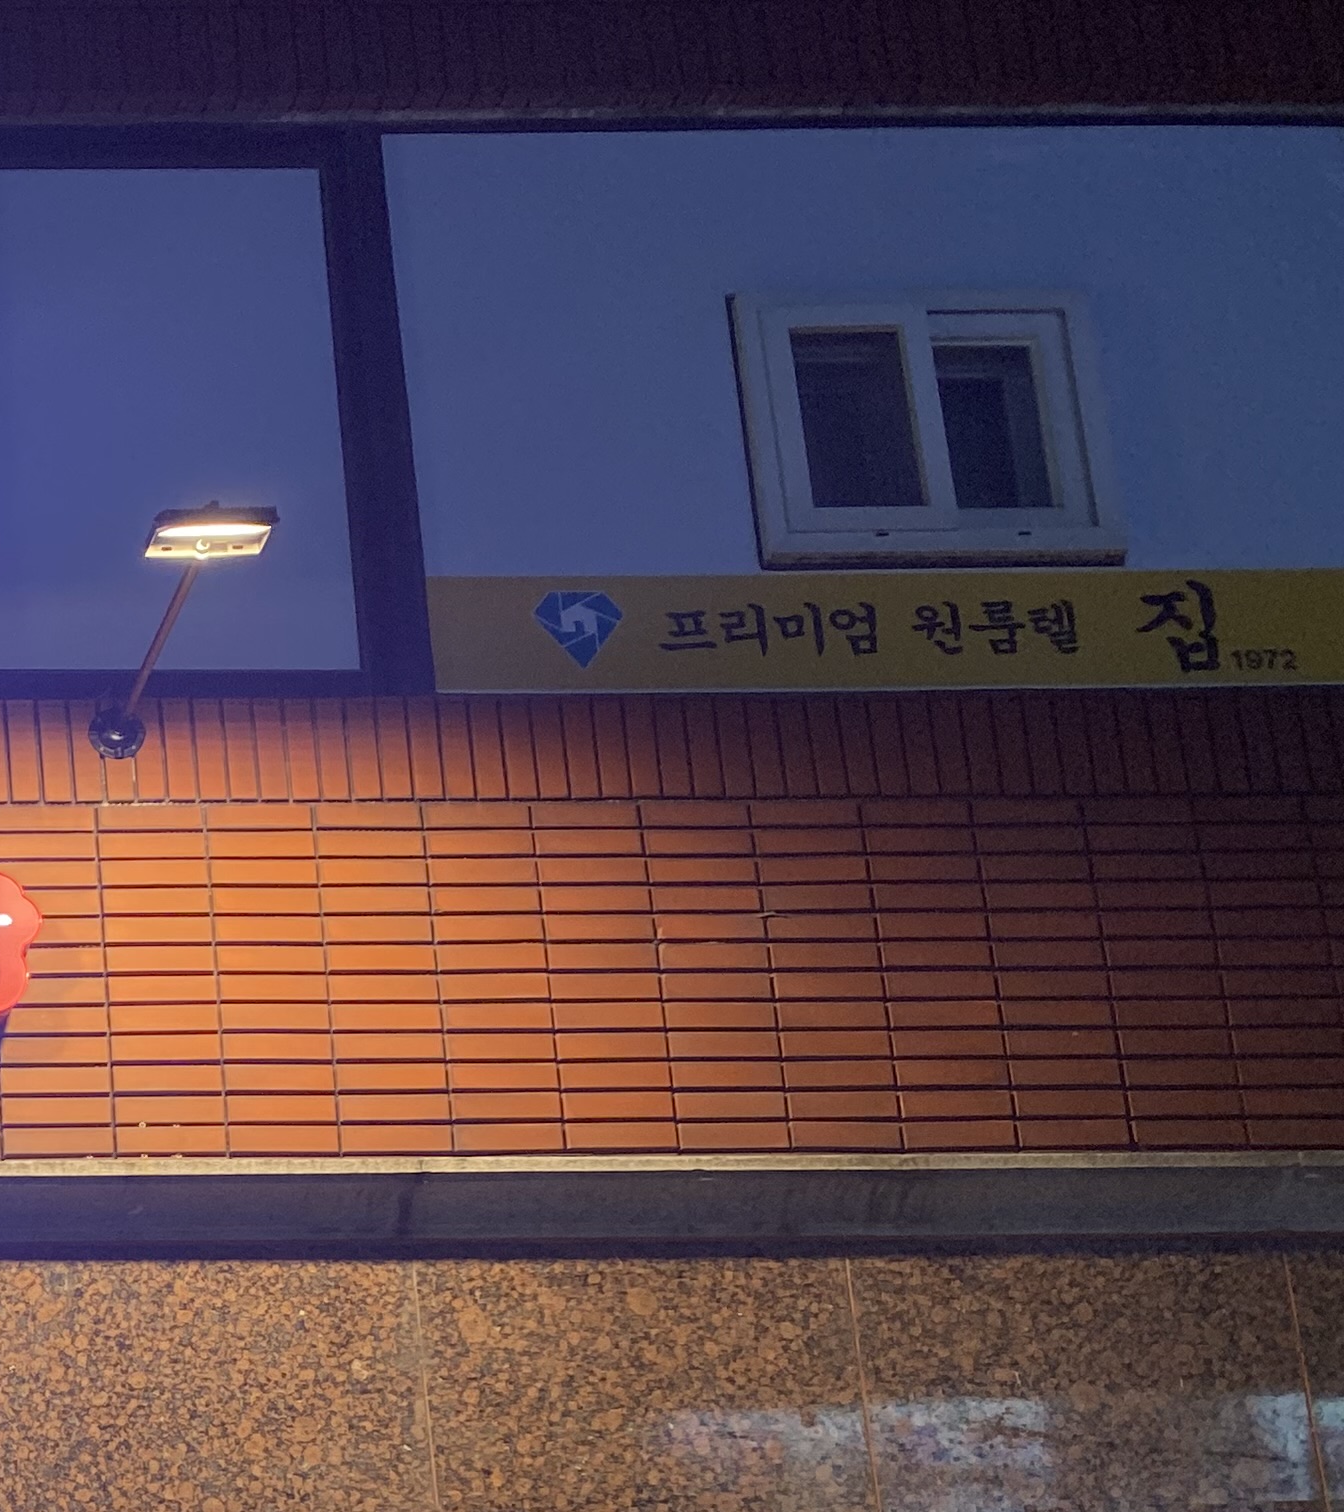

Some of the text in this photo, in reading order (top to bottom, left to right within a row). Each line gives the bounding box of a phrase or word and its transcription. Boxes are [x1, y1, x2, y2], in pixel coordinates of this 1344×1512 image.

[658, 600, 881, 658] 프리미엄
[1133, 579, 1222, 675] 집
[1229, 647, 1301, 673] 1972
